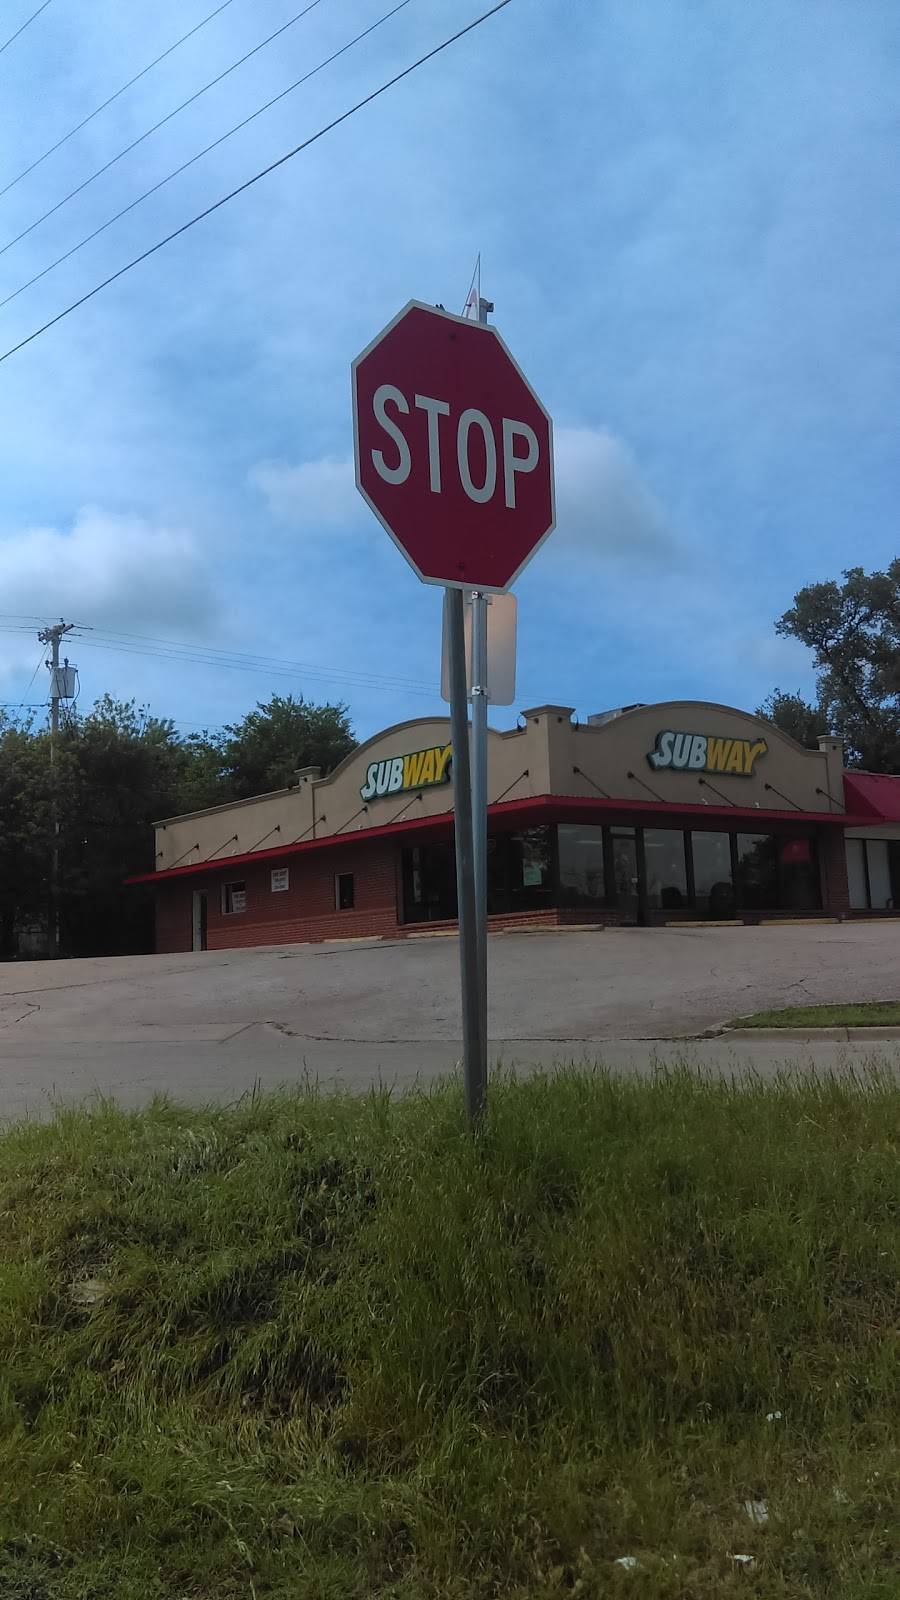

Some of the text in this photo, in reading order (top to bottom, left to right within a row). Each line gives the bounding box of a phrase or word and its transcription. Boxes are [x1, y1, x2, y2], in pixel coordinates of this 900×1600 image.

[371, 384, 540, 509] STOP
[361, 744, 453, 797] SUBWAY
[651, 731, 767, 773] SUBWAY
